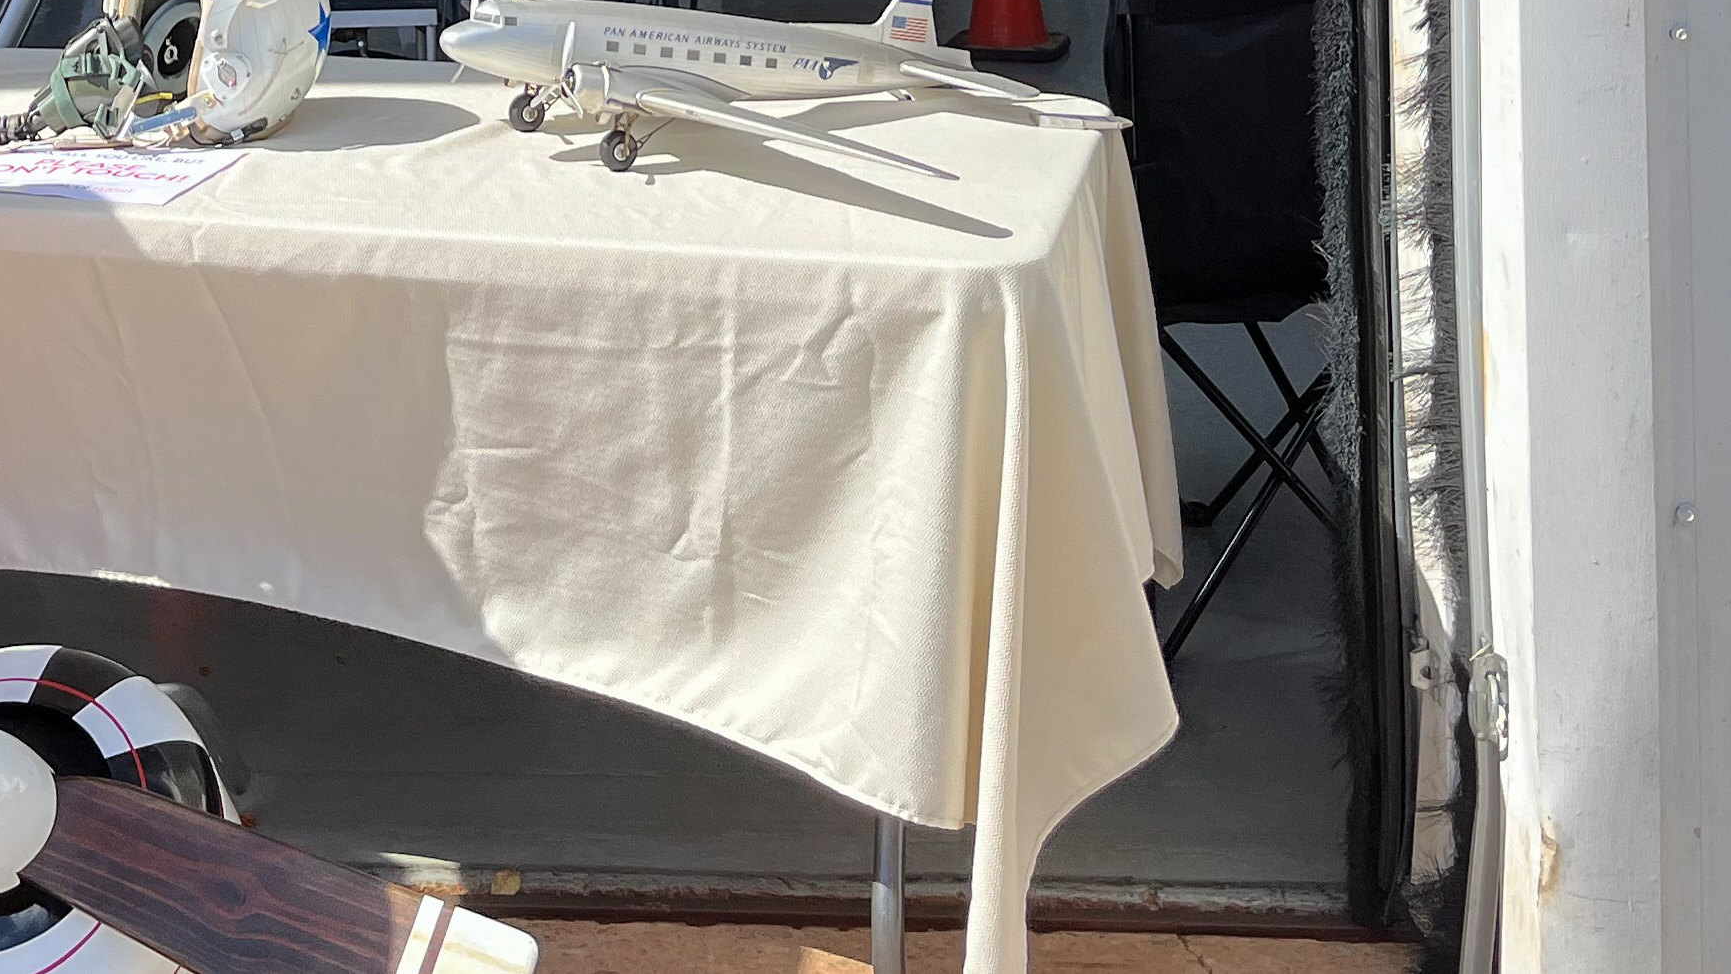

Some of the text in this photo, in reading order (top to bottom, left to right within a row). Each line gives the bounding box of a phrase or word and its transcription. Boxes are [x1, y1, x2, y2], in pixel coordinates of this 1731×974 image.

[604, 26, 787, 54] PAN AMERICAN AIRWAYS SYSTEM
[34, 158, 147, 171] PLEASE
[172, 157, 206, 165] BUT
[70, 167, 190, 183] TOUCH!
